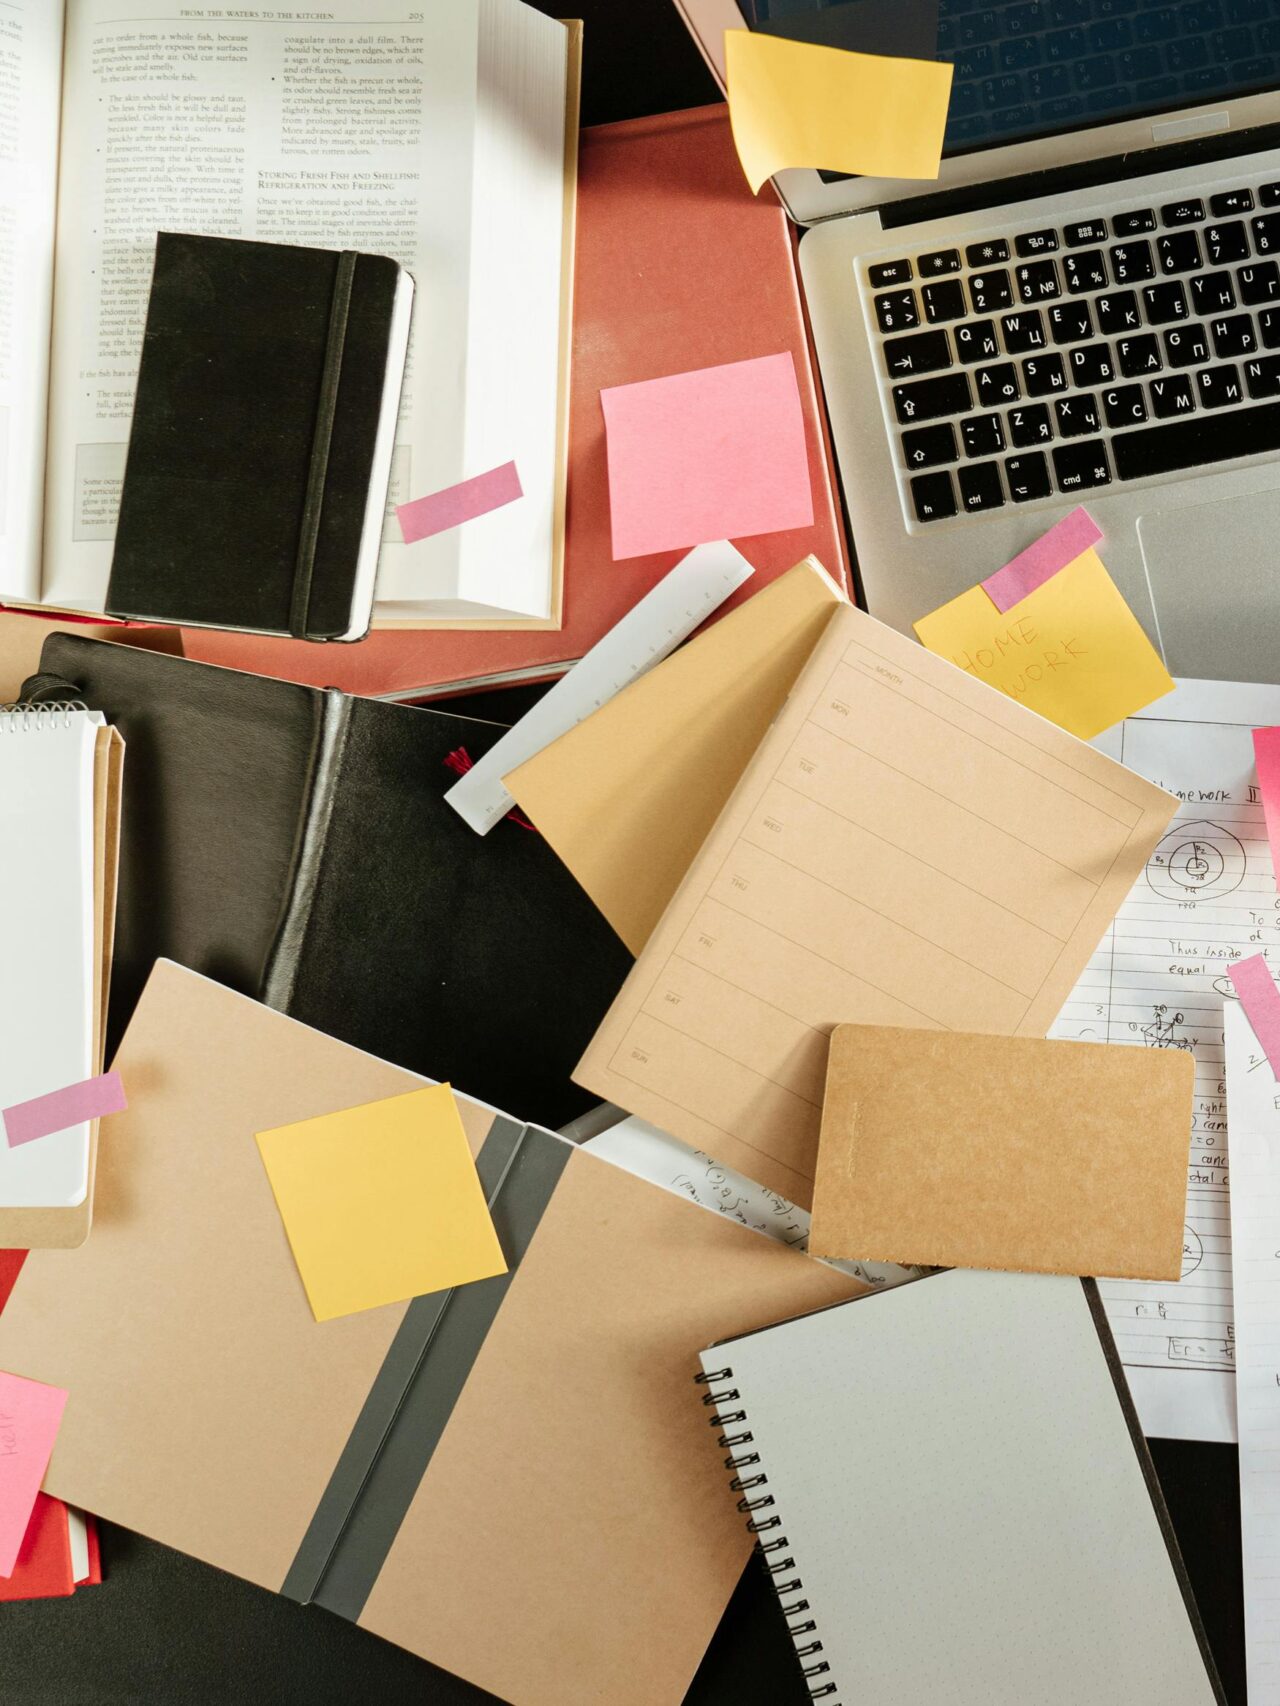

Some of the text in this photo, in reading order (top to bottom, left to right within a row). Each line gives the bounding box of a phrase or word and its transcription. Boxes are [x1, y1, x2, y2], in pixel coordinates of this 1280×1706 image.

[408, 13, 424, 21] 205
[284, 36, 325, 45] coagulate
[328, 36, 345, 44] into
[357, 36, 374, 44] dull
[377, 36, 396, 44] film.
[401, 36, 423, 44] There
[258, 170, 297, 180] STORING
[300, 171, 327, 180] FRESH
[331, 171, 349, 180] FISH
[352, 172, 370, 180] AND
[258, 180, 395, 191] REFRIGERATION AND FREEZING
[1260, 237, 1269, 249] 8
[882, 268, 897, 277] esc
[1119, 265, 1127, 278] 5
[1242, 269, 1254, 283] U
[1023, 285, 1033, 297] 3
[1194, 280, 1204, 293] Y
[976, 294, 986, 307] 2
[1147, 289, 1156, 303] T
[1100, 299, 1111, 313] R
[1053, 309, 1062, 322] E
[1264, 313, 1272, 328] J
[1005, 318, 1019, 332] W
[1216, 322, 1228, 336] H
[959, 328, 972, 342] Q
[1169, 332, 1181, 346] G
[1121, 342, 1129, 356] F
[1074, 352, 1085, 365] D
[1027, 362, 1037, 375] S
[1249, 363, 1261, 377] N
[981, 372, 992, 385] A
[1202, 374, 1212, 387] B
[1002, 384, 1015, 396] Ф
[1154, 382, 1164, 396] V
[1107, 392, 1118, 406] C
[1060, 402, 1072, 416] X
[1013, 412, 1024, 426] Z
[1063, 473, 1081, 486] cmd
[968, 493, 982, 505] ctrl
[952, 616, 1038, 673] HOME
[875, 665, 905, 685] MONTH
[1001, 638, 1088, 700] WORK
[831, 701, 849, 716] MON
[799, 762, 816, 775] TUE
[763, 819, 783, 833] WED
[731, 878, 748, 891] THU
[698, 936, 714, 948] FRI
[664, 993, 681, 1006] SAT
[631, 1050, 648, 1064] SUN
